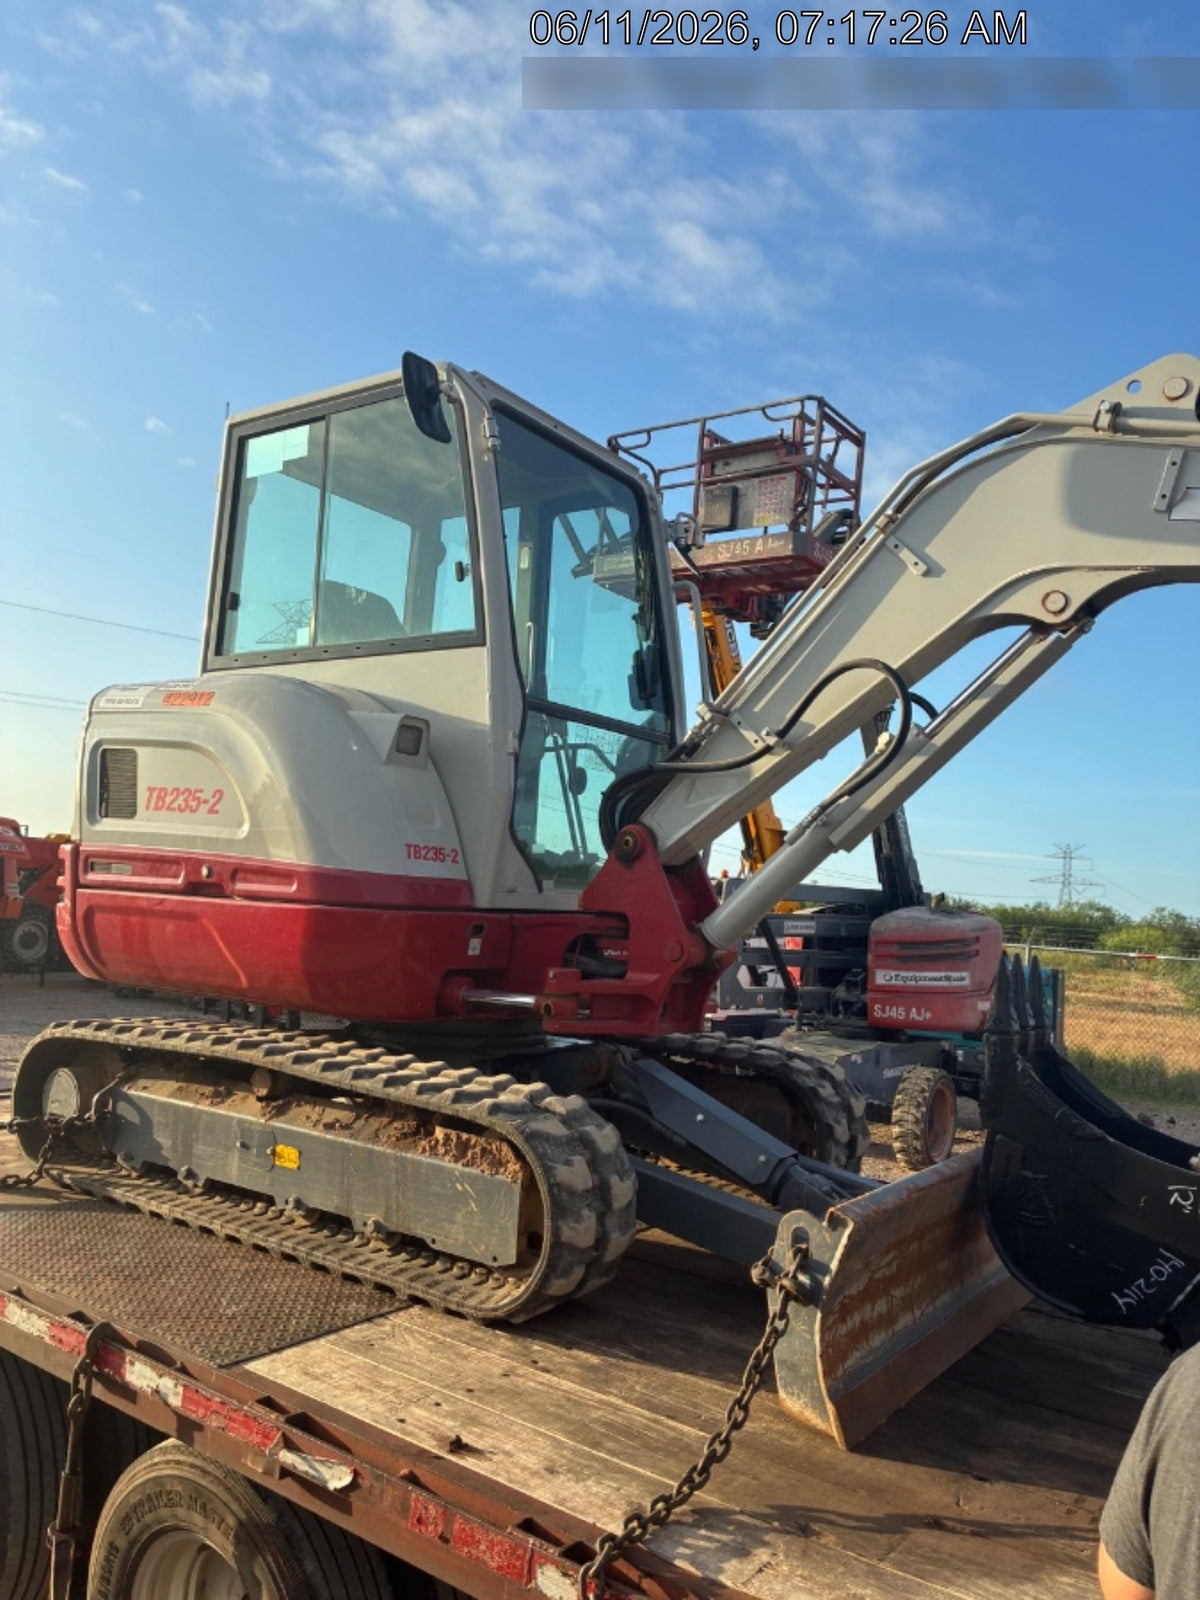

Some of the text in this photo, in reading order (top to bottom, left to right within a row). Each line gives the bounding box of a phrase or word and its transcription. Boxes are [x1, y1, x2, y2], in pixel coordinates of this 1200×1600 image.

[145, 786, 224, 815] TB235-2
[404, 843, 459, 865] TB235-2
[873, 1003, 906, 1020] SJ45
